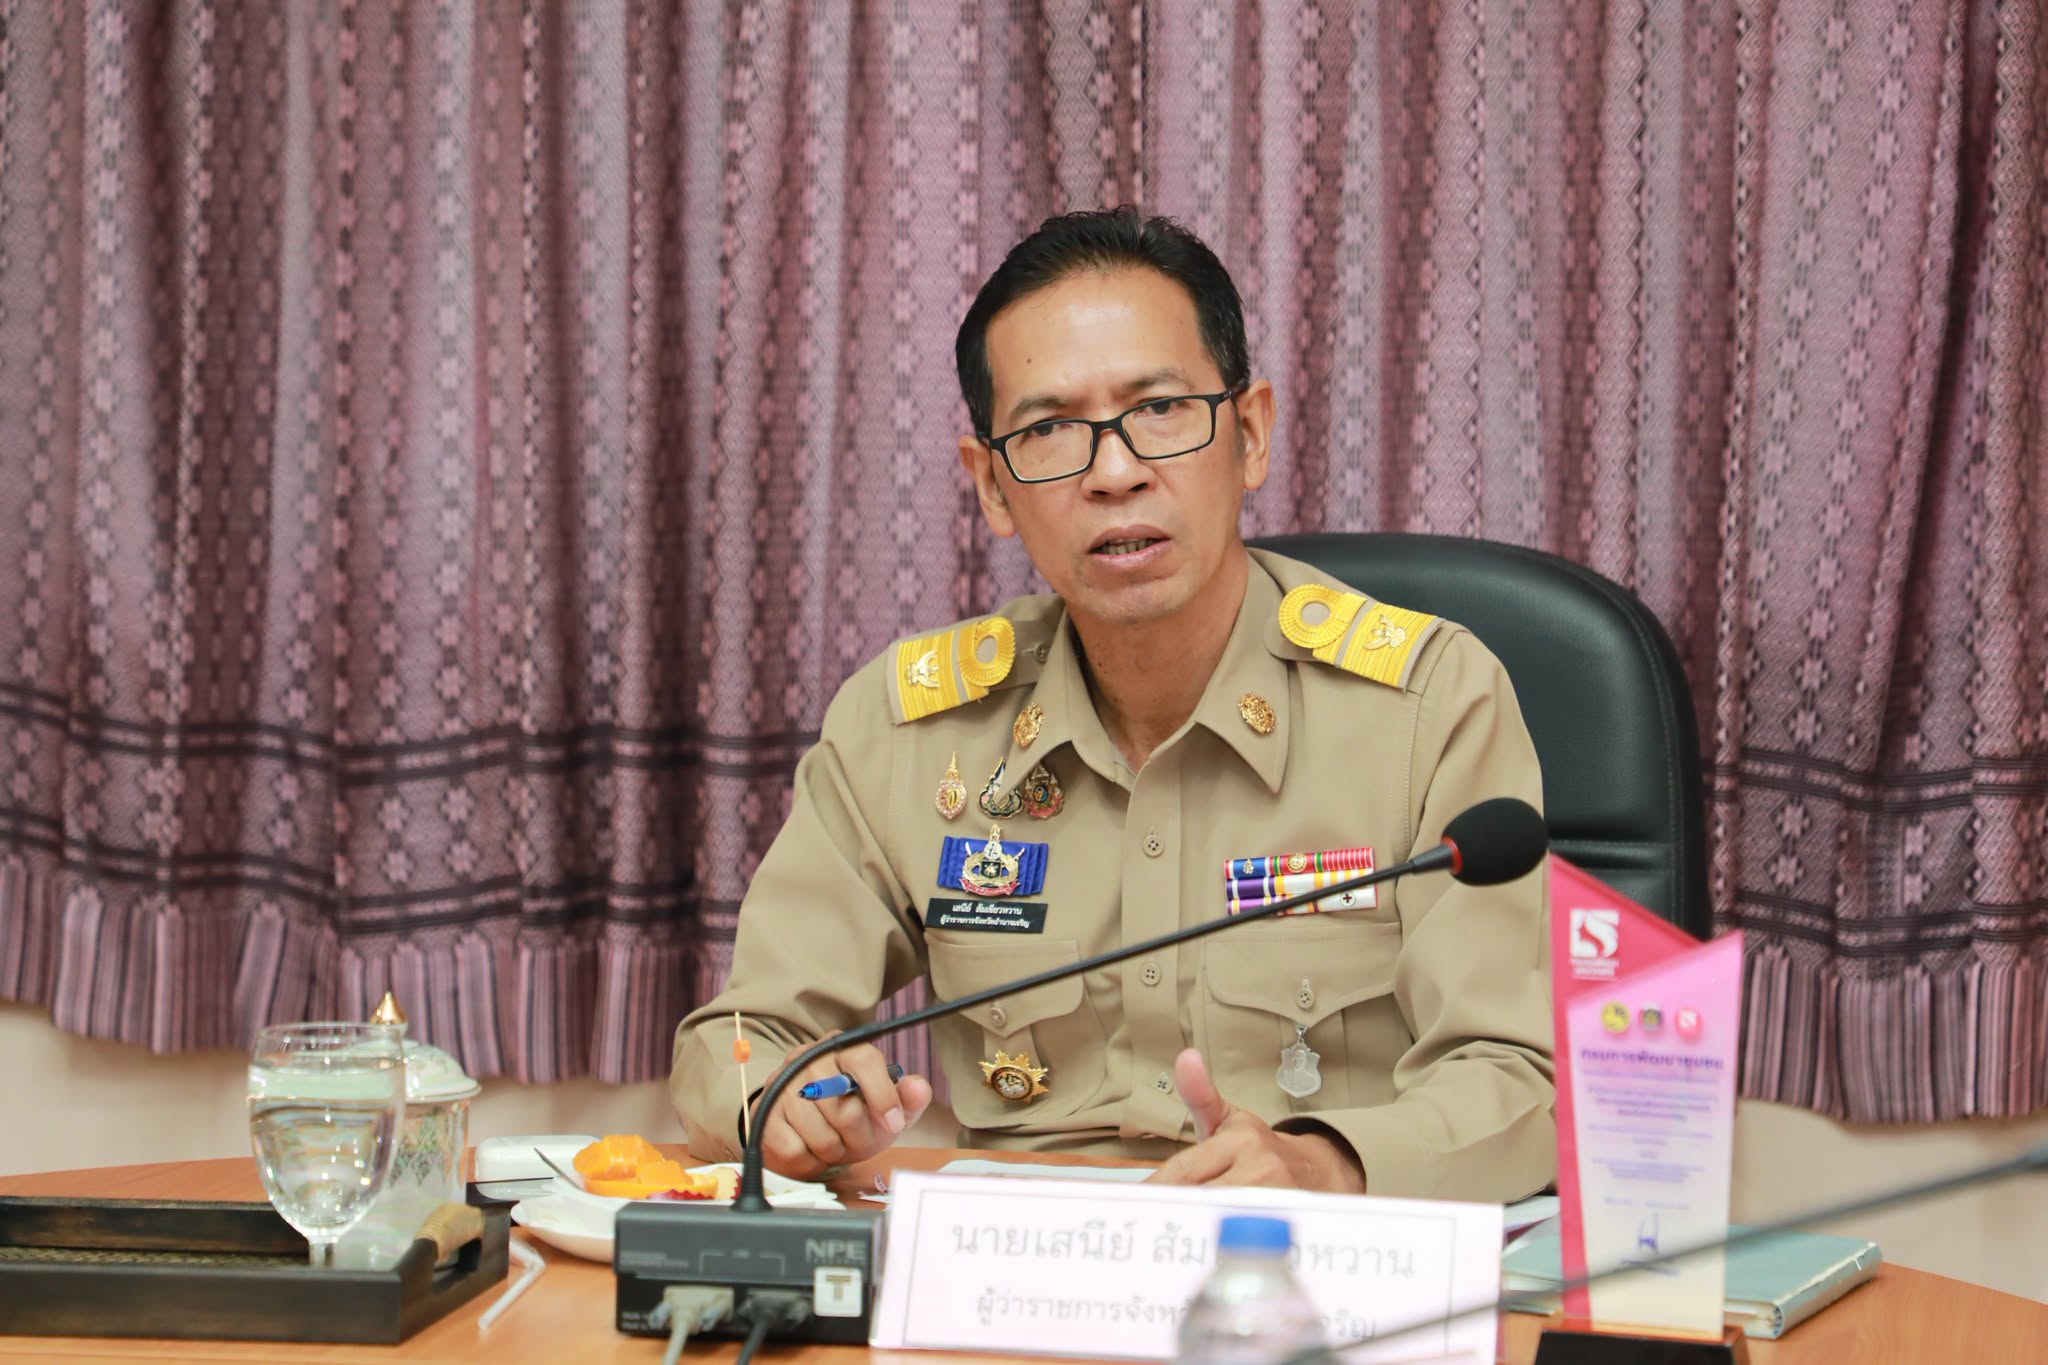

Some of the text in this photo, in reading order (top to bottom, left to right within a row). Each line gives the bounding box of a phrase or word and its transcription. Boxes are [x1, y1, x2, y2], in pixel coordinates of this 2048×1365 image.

[805, 1239, 866, 1260] NPE
[952, 1218, 1415, 1277] นายเสนีย์ ส้มวหวาน
[825, 1275, 851, 1301] T
